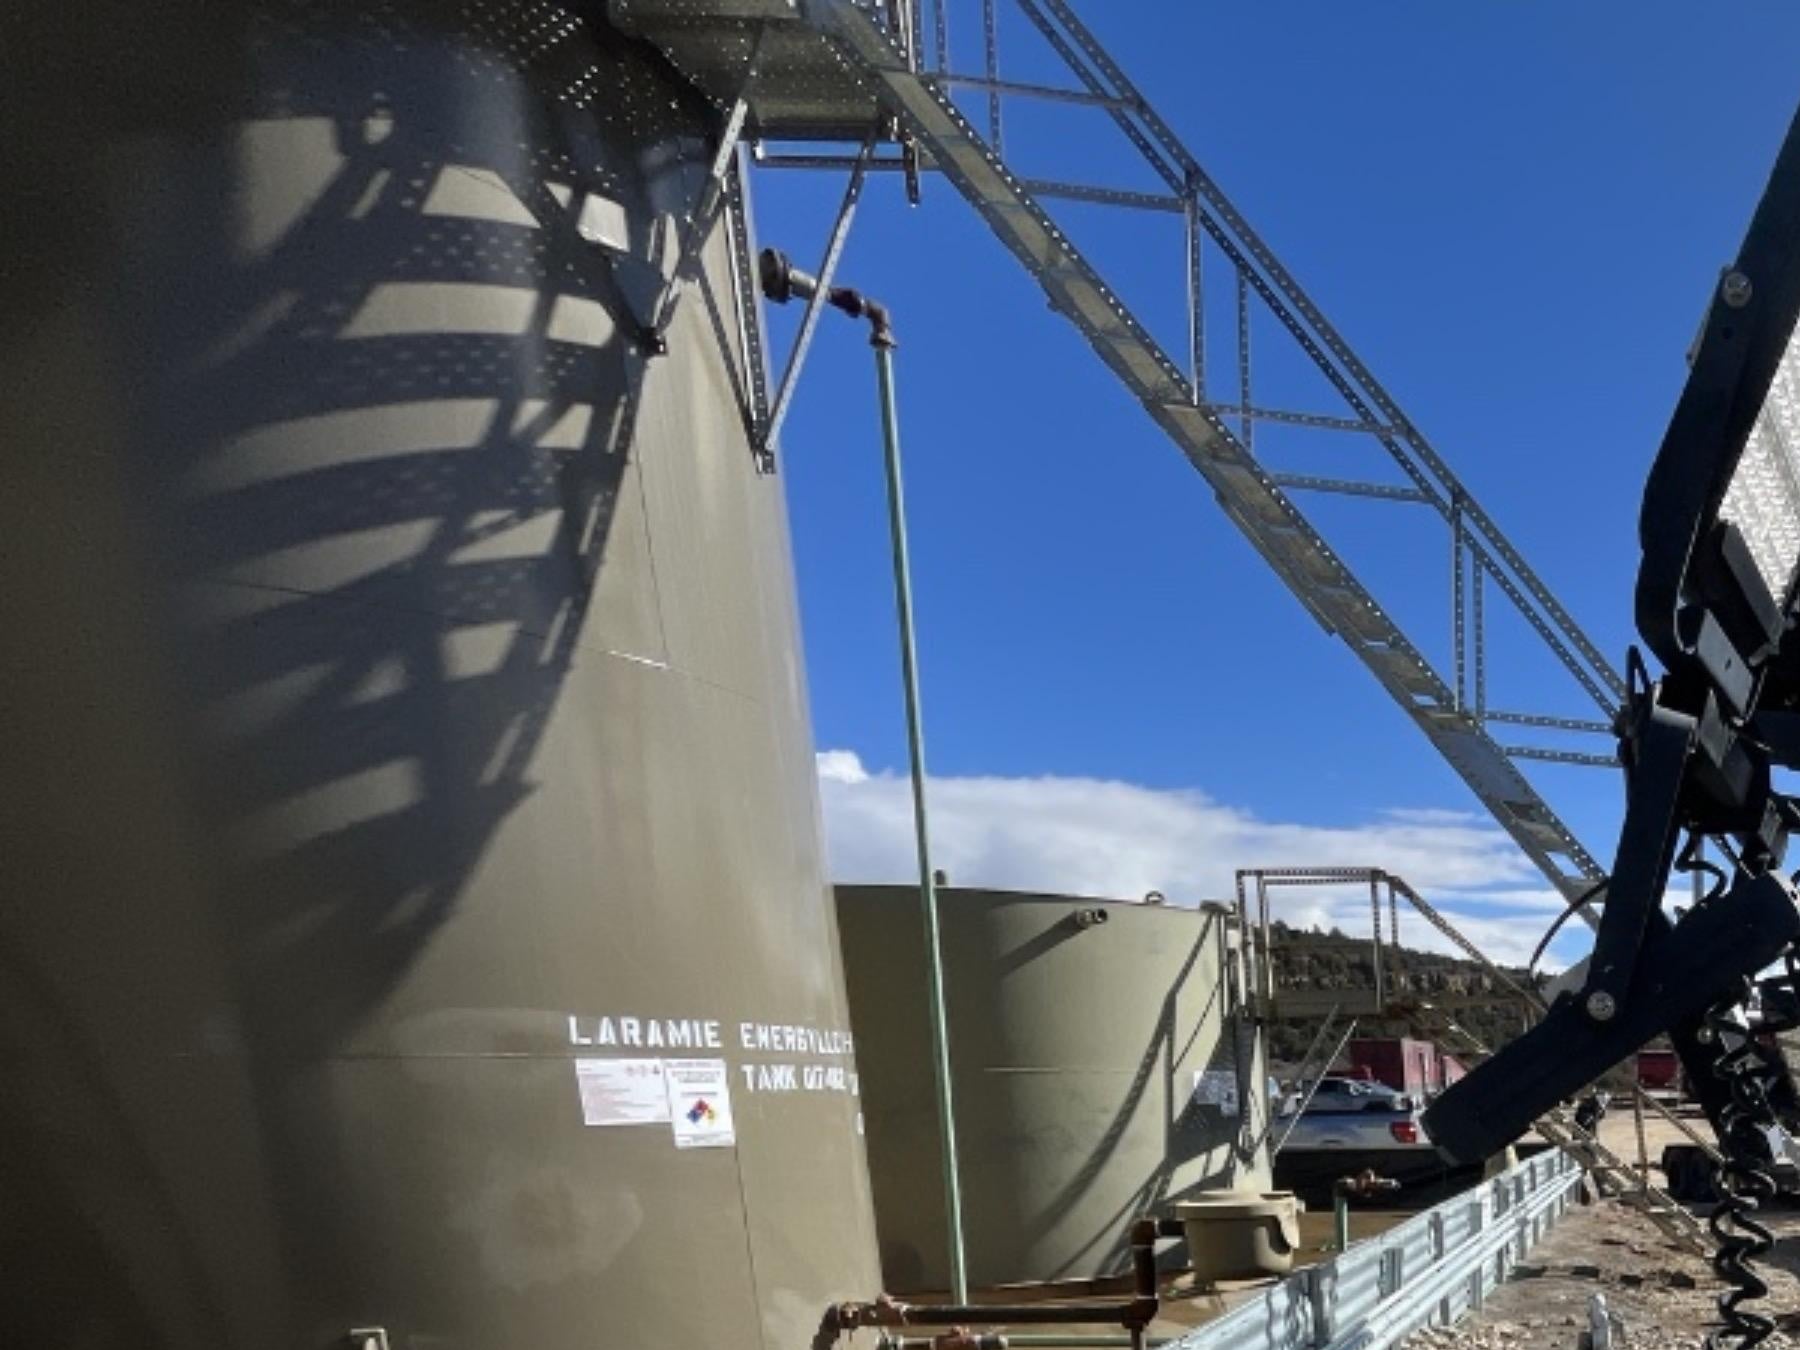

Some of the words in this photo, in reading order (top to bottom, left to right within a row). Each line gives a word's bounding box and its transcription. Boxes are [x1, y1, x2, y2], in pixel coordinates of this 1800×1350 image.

[568, 1015, 723, 1048] LARAMIE
[740, 1022, 817, 1053] ENERGY
[741, 1064, 798, 1092] TANK
